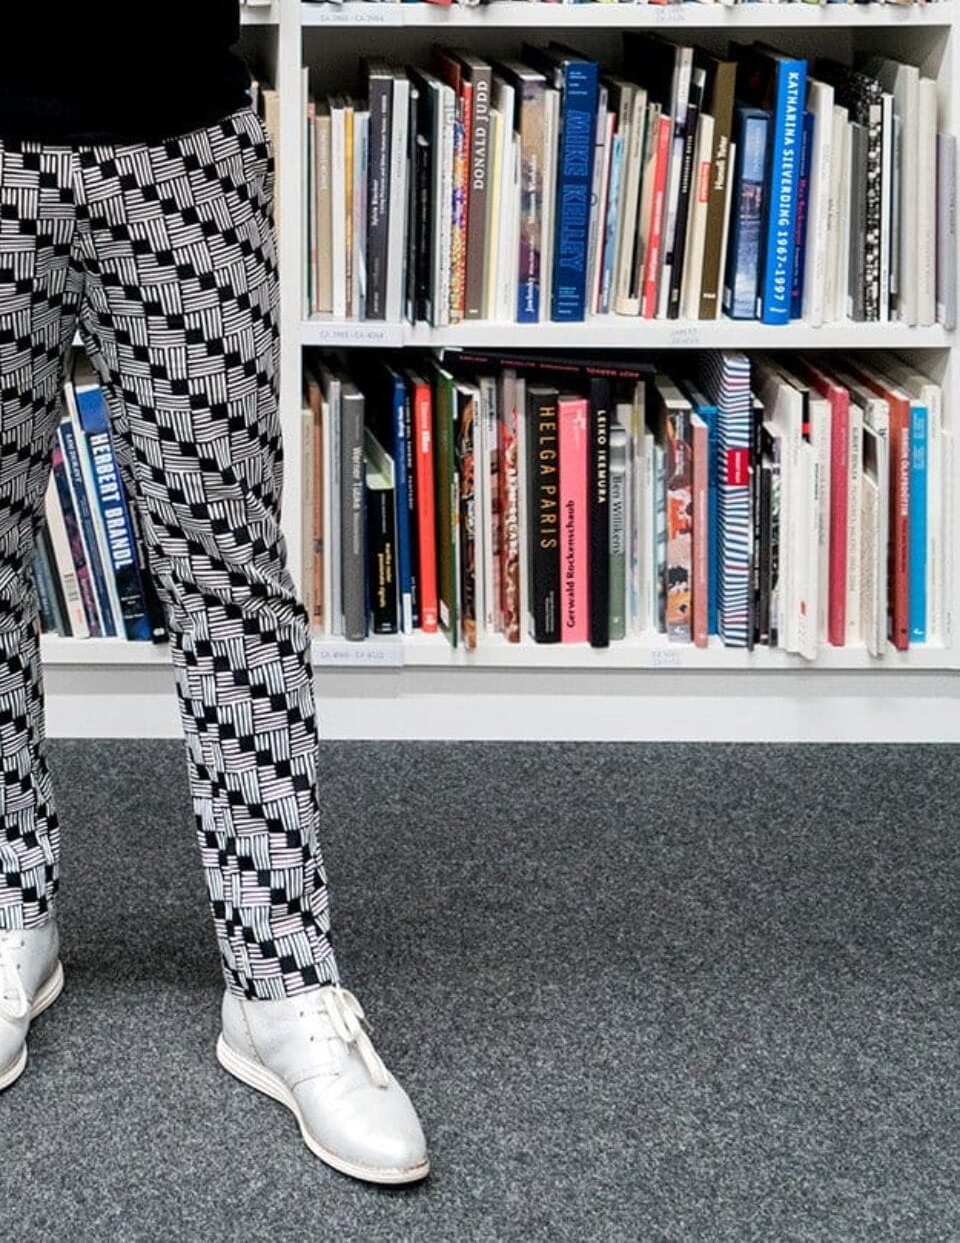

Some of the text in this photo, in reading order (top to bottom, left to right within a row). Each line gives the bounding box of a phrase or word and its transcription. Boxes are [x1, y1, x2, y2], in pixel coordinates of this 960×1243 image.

[474, 80, 488, 189] DONALD JUDD
[560, 109, 588, 270] MIKE KELLEY
[774, 71, 799, 303] KATHARINA SIEVERDING 1967-1997
[89, 432, 133, 569] HERBERT BRANDL
[351, 446, 362, 476] Werner
[539, 406, 558, 549] HELGA PARIS
[597, 409, 607, 504] LEIKO IKEMURA
[611, 476, 623, 555] Ben Willikens
[565, 500, 576, 628] Gerwald Rockenschaub
